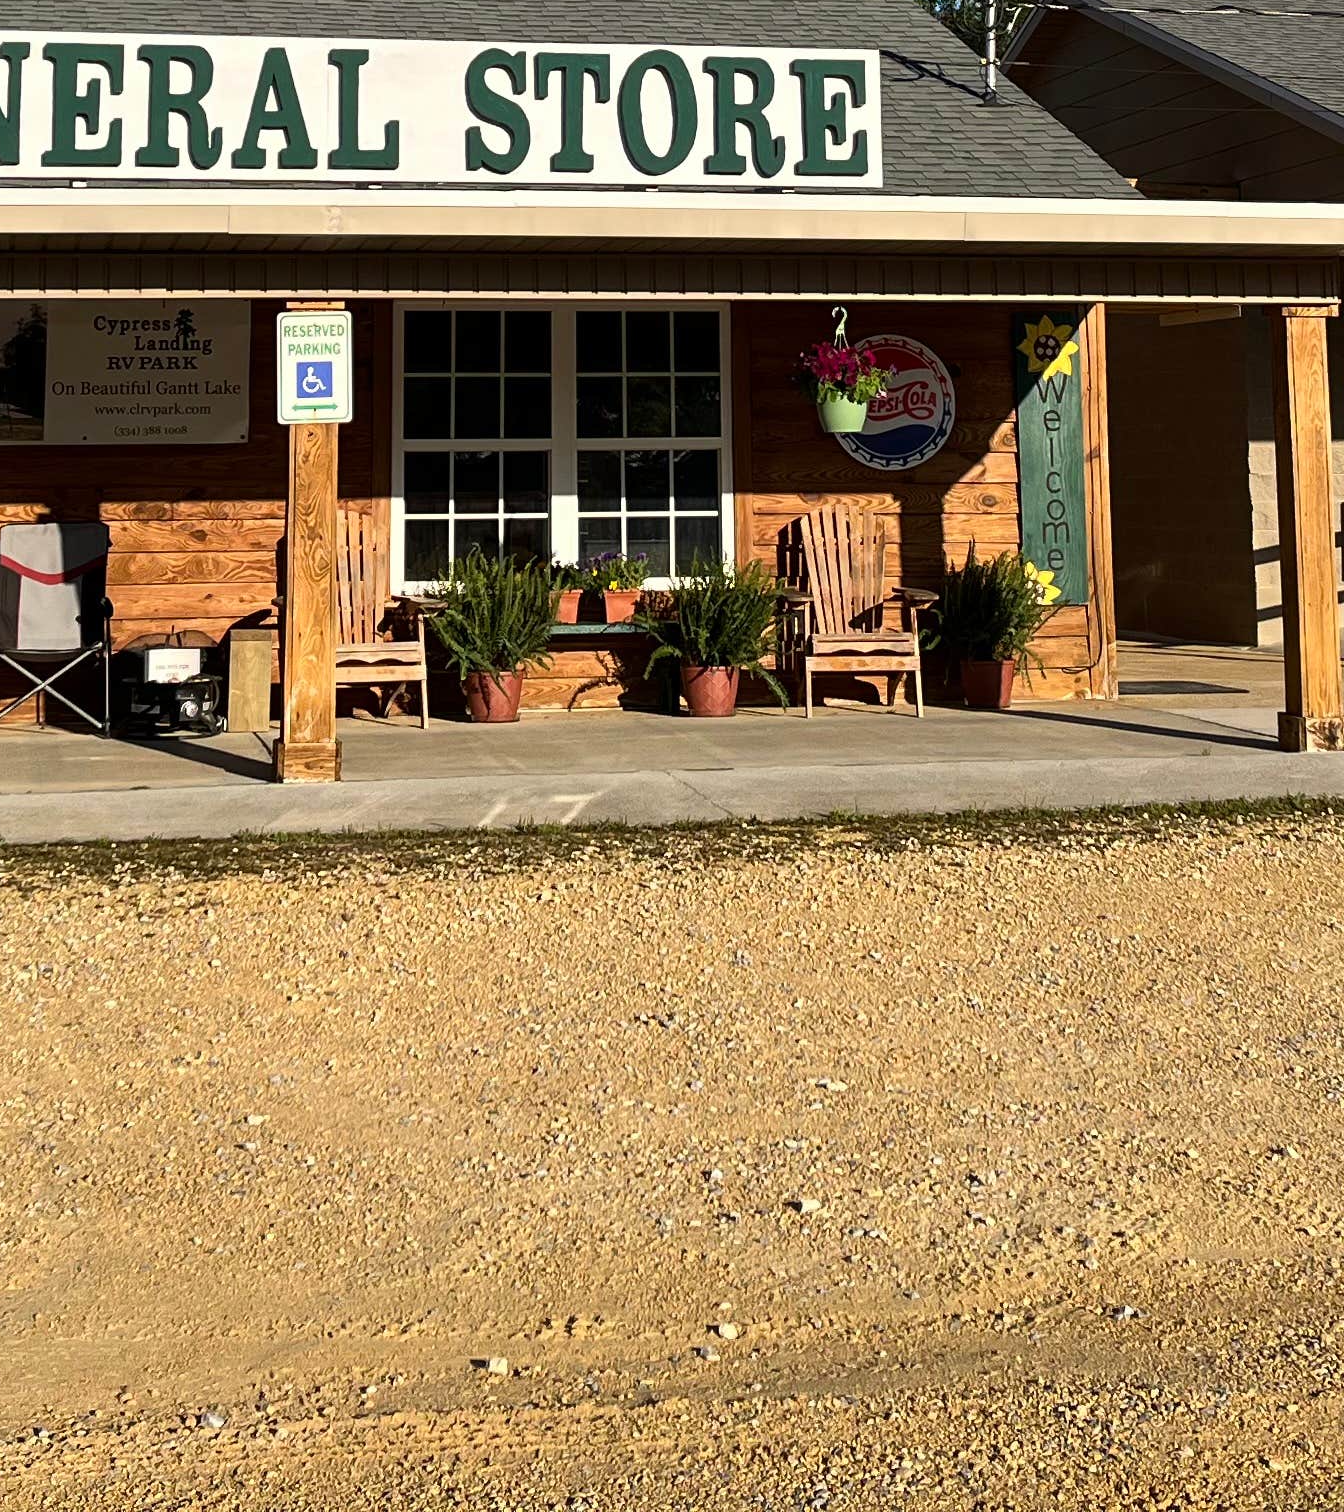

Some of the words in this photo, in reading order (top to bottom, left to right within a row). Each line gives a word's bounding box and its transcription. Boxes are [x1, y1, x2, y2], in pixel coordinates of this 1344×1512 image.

[464, 48, 868, 178] STORE
[93, 315, 171, 336] Cypress
[283, 324, 345, 337] RESERVED
[134, 335, 212, 355] Landing
[288, 342, 341, 356] PARKING
[106, 356, 135, 370] RV
[139, 356, 198, 370] PARK
[51, 381, 75, 396] On
[80, 380, 151, 396] Beautiful
[156, 381, 199, 396] Gantt
[205, 380, 241, 396] Lake
[867, 381, 937, 421] EPSI-COLA
[95, 403, 211, 418] www.clrvpark.com
